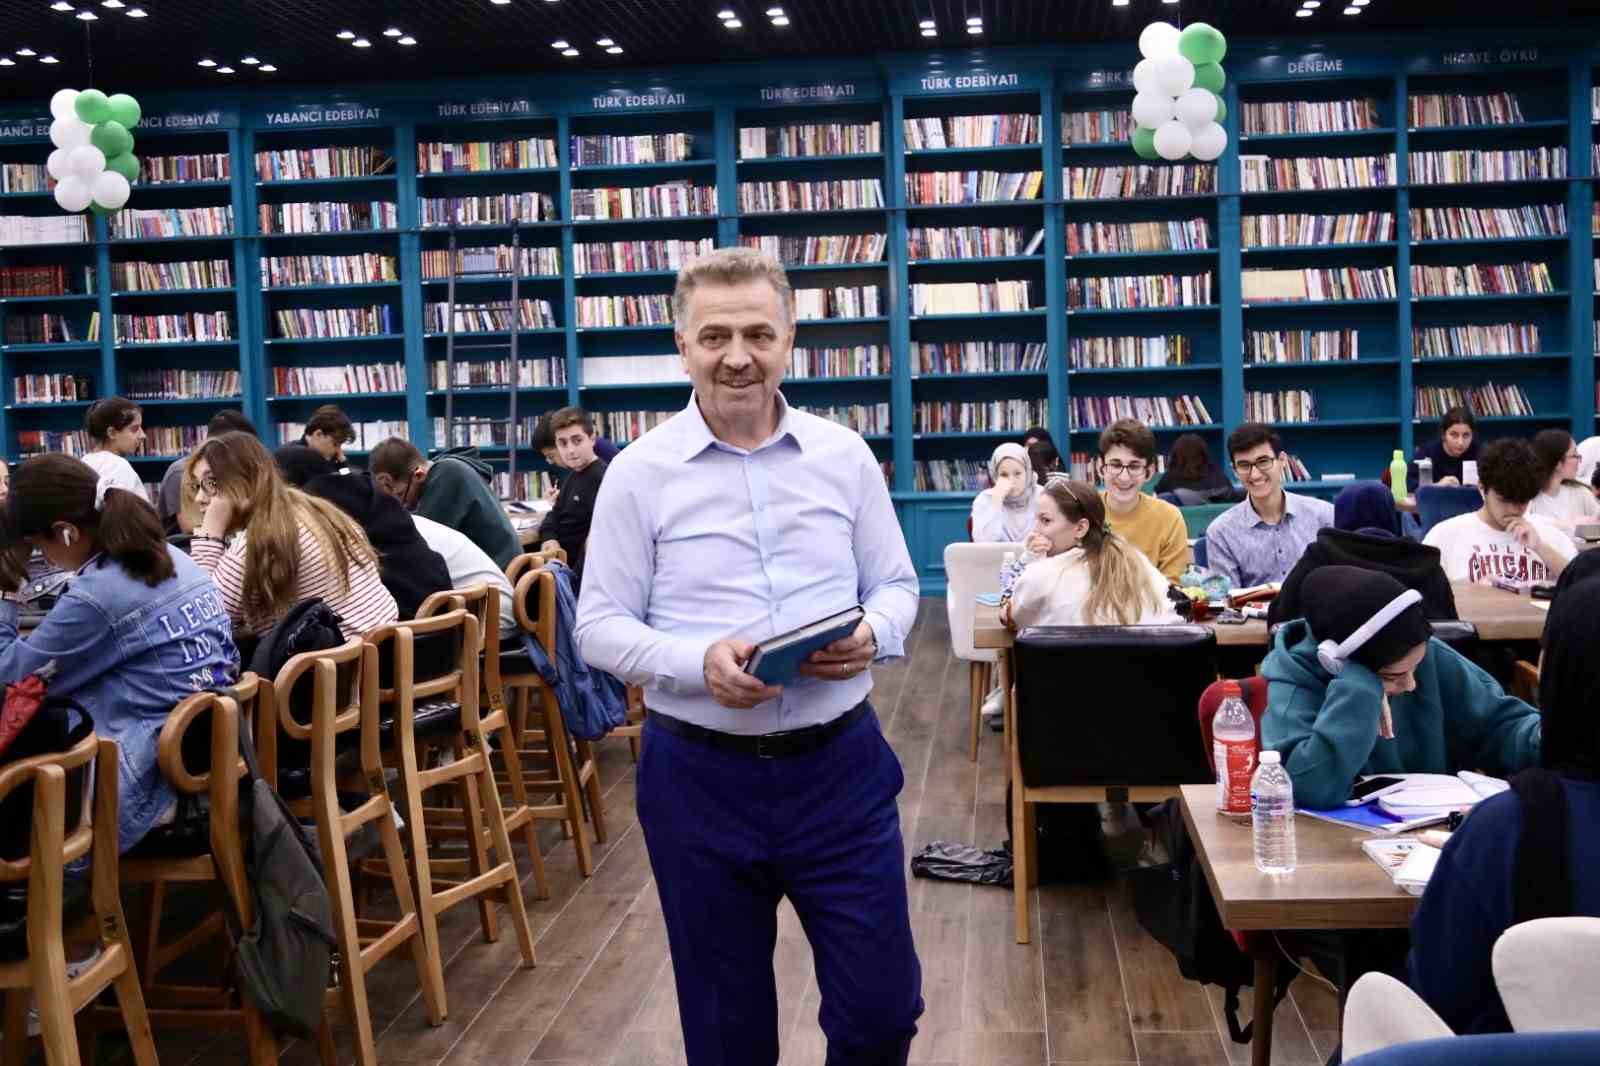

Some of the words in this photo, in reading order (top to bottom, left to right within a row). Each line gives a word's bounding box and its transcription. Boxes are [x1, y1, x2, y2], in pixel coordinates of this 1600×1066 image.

[1287, 59, 1344, 74] DENEME
[921, 76, 952, 90] TÜRK
[955, 73, 1018, 88] EDEBİYATI
[592, 96, 622, 109] TÜRK
[625, 93, 686, 107] EDEBİYATI
[266, 111, 322, 125] YABANCI
[325, 107, 380, 121] EDEBİYAT
[438, 103, 467, 116] TÜRK
[138, 117, 162, 128] NCI
